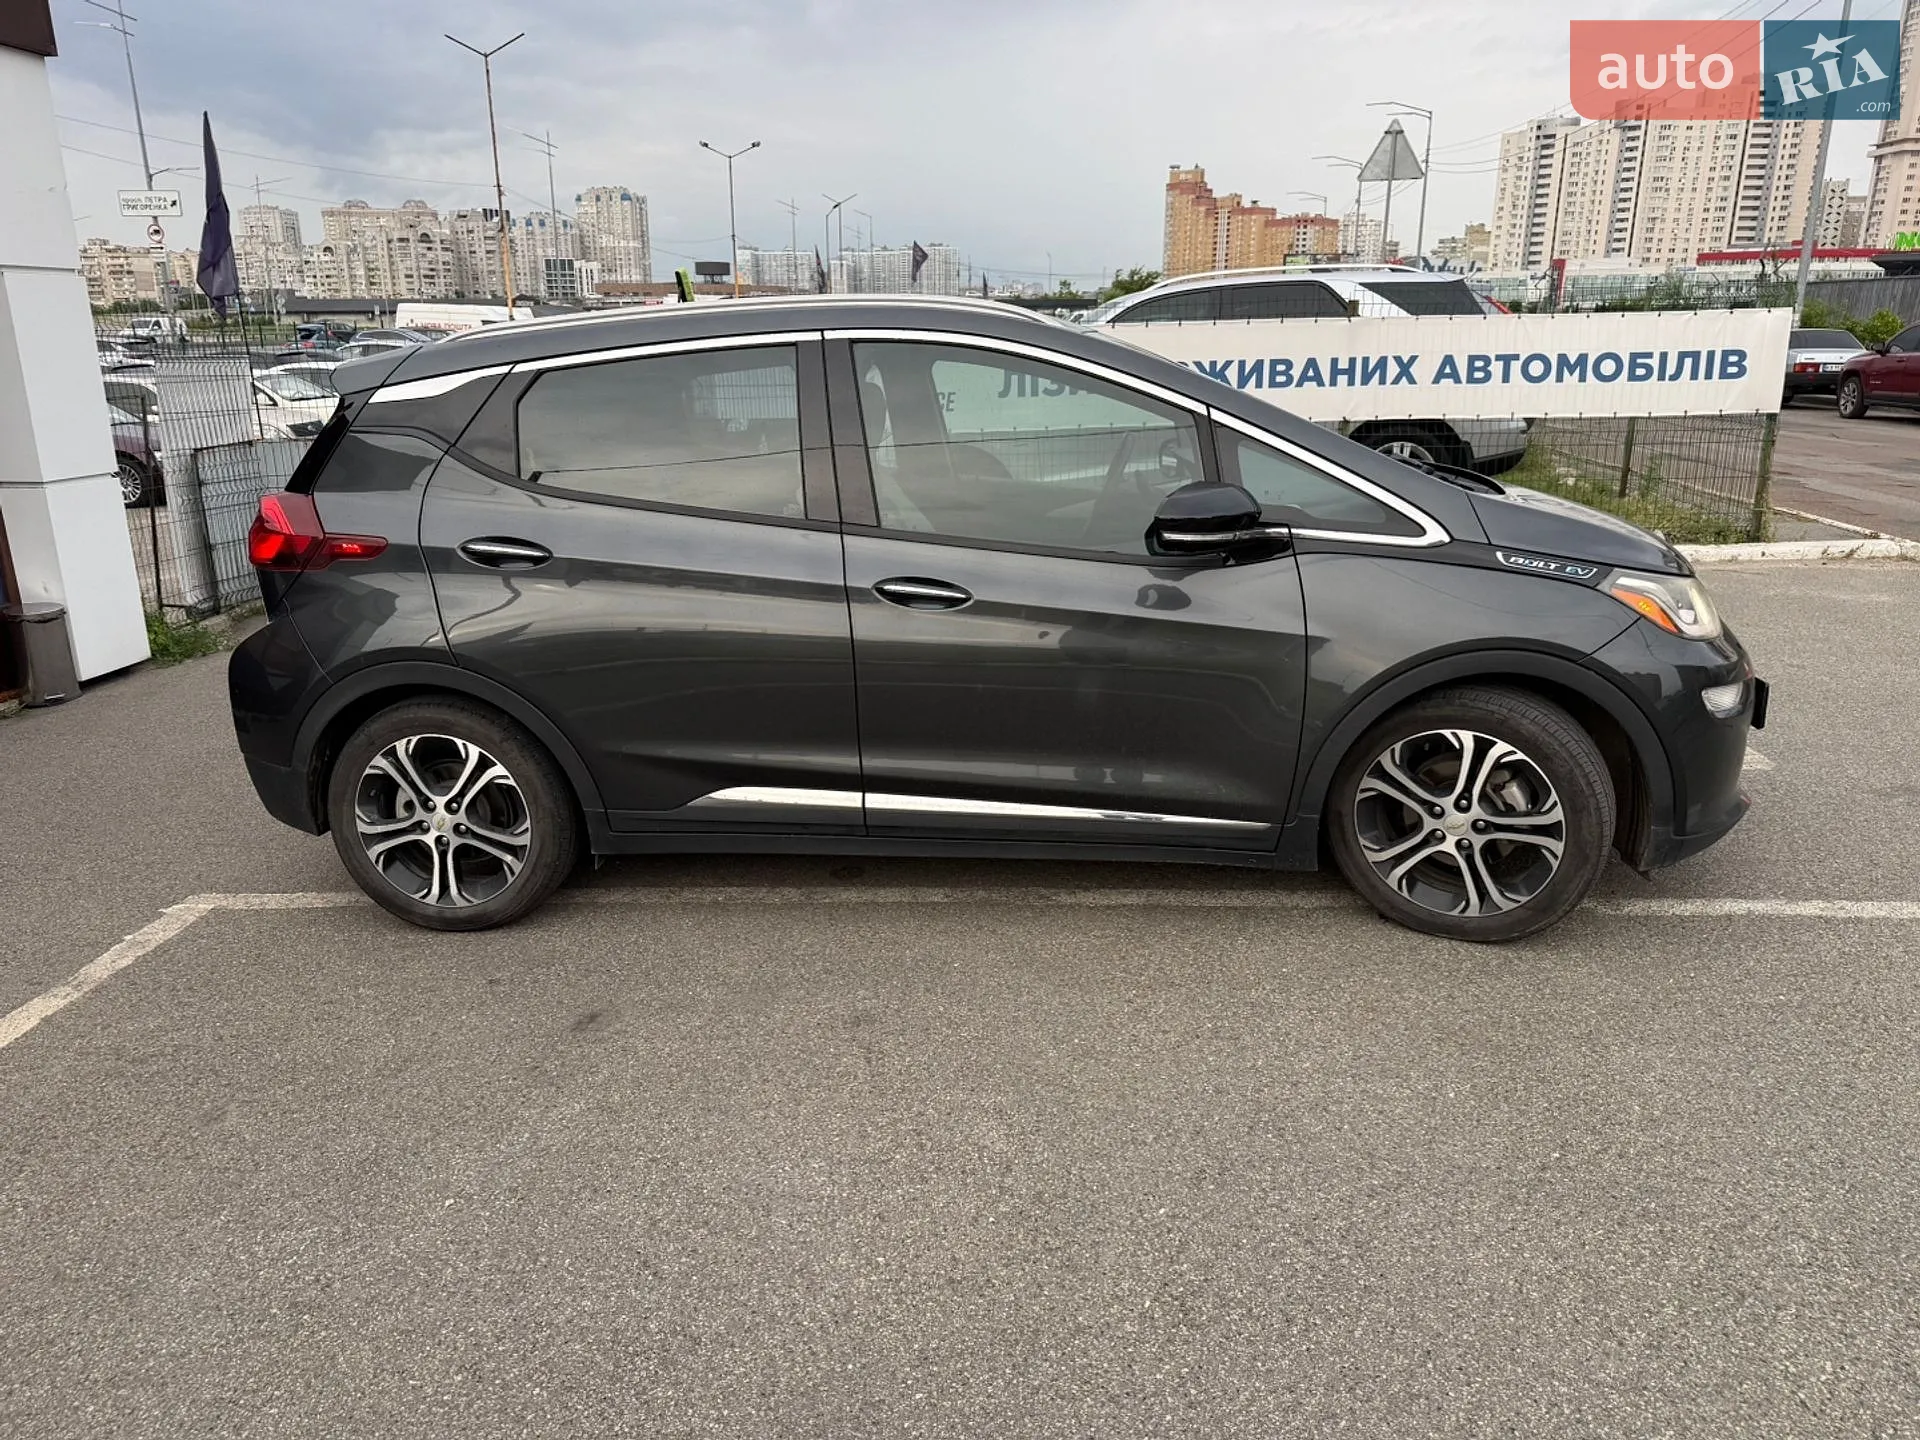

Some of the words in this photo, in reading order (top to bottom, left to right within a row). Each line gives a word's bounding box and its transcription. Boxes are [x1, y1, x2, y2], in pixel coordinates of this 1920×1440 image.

[144, 196, 168, 204] ПЕТРА
[1178, 354, 1419, 389] ЖИВАНИХ
[1431, 349, 1748, 385] АВТОМОБІЛІВ
[1508, 556, 1561, 570] BOLT
[1564, 565, 1590, 575] EV
